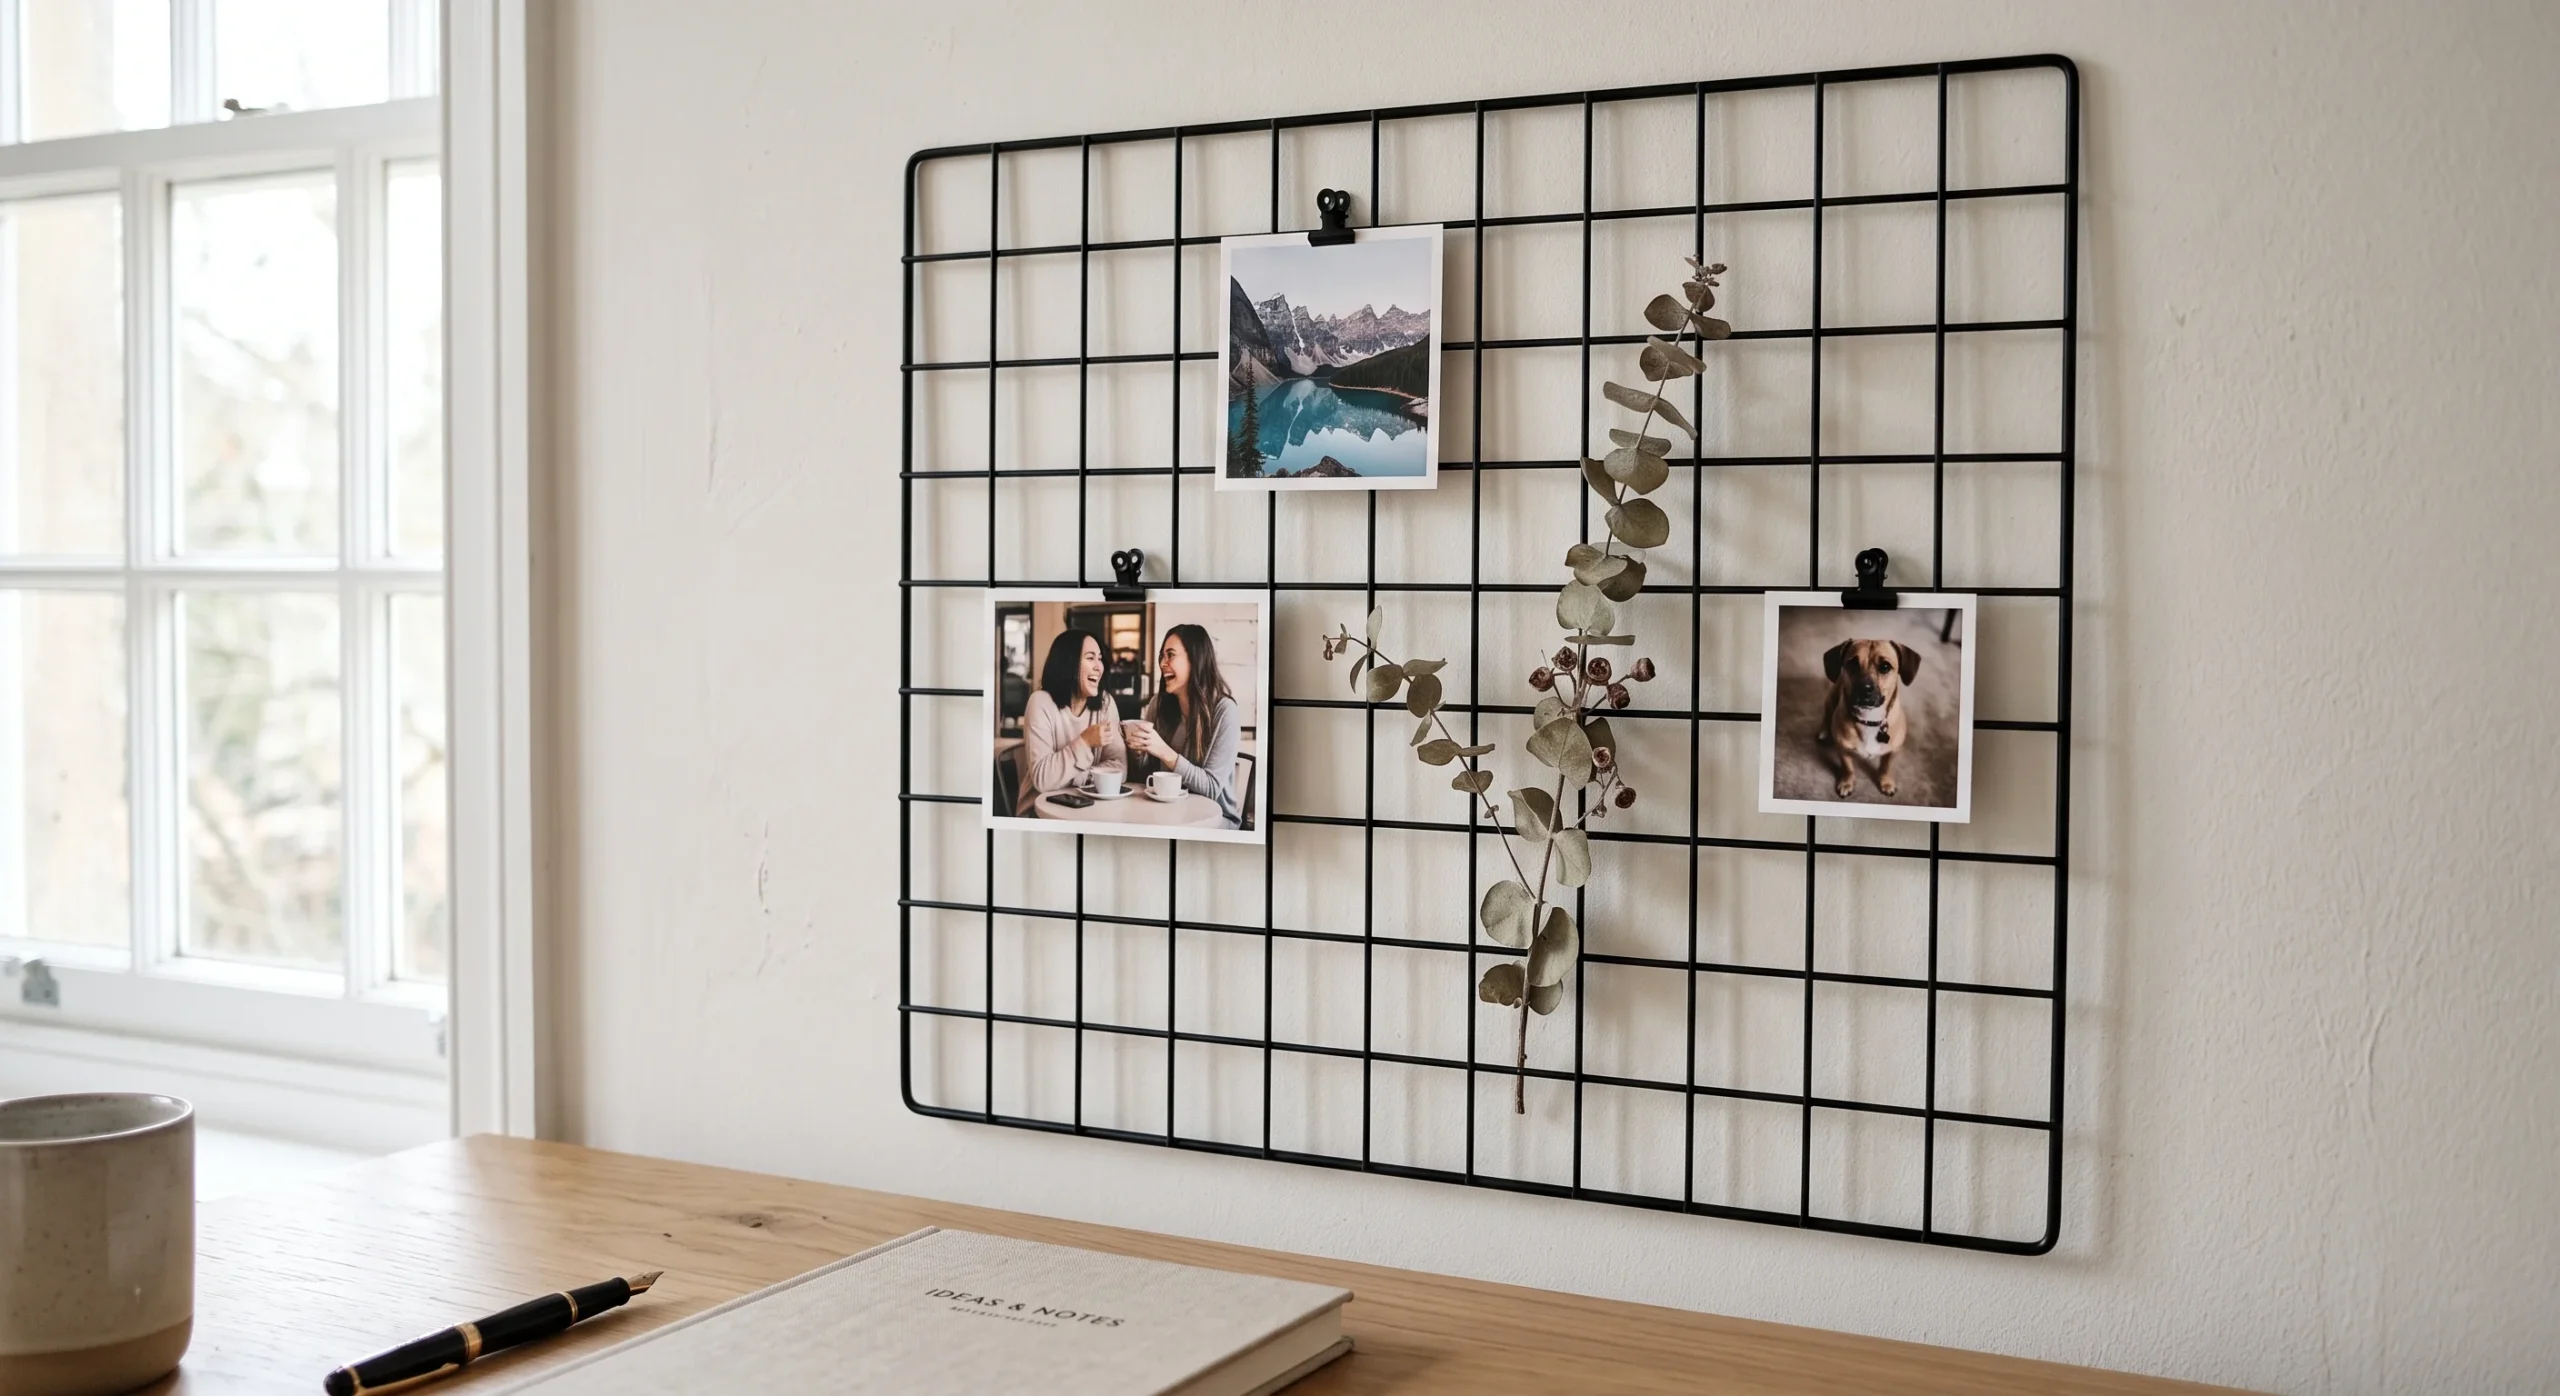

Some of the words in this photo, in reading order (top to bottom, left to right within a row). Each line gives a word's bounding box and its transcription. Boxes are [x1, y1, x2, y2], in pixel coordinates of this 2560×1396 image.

[925, 1288, 1004, 1306] IDEAS
[1008, 1302, 1026, 1311] &
[1032, 1306, 1125, 1327] NOTES
